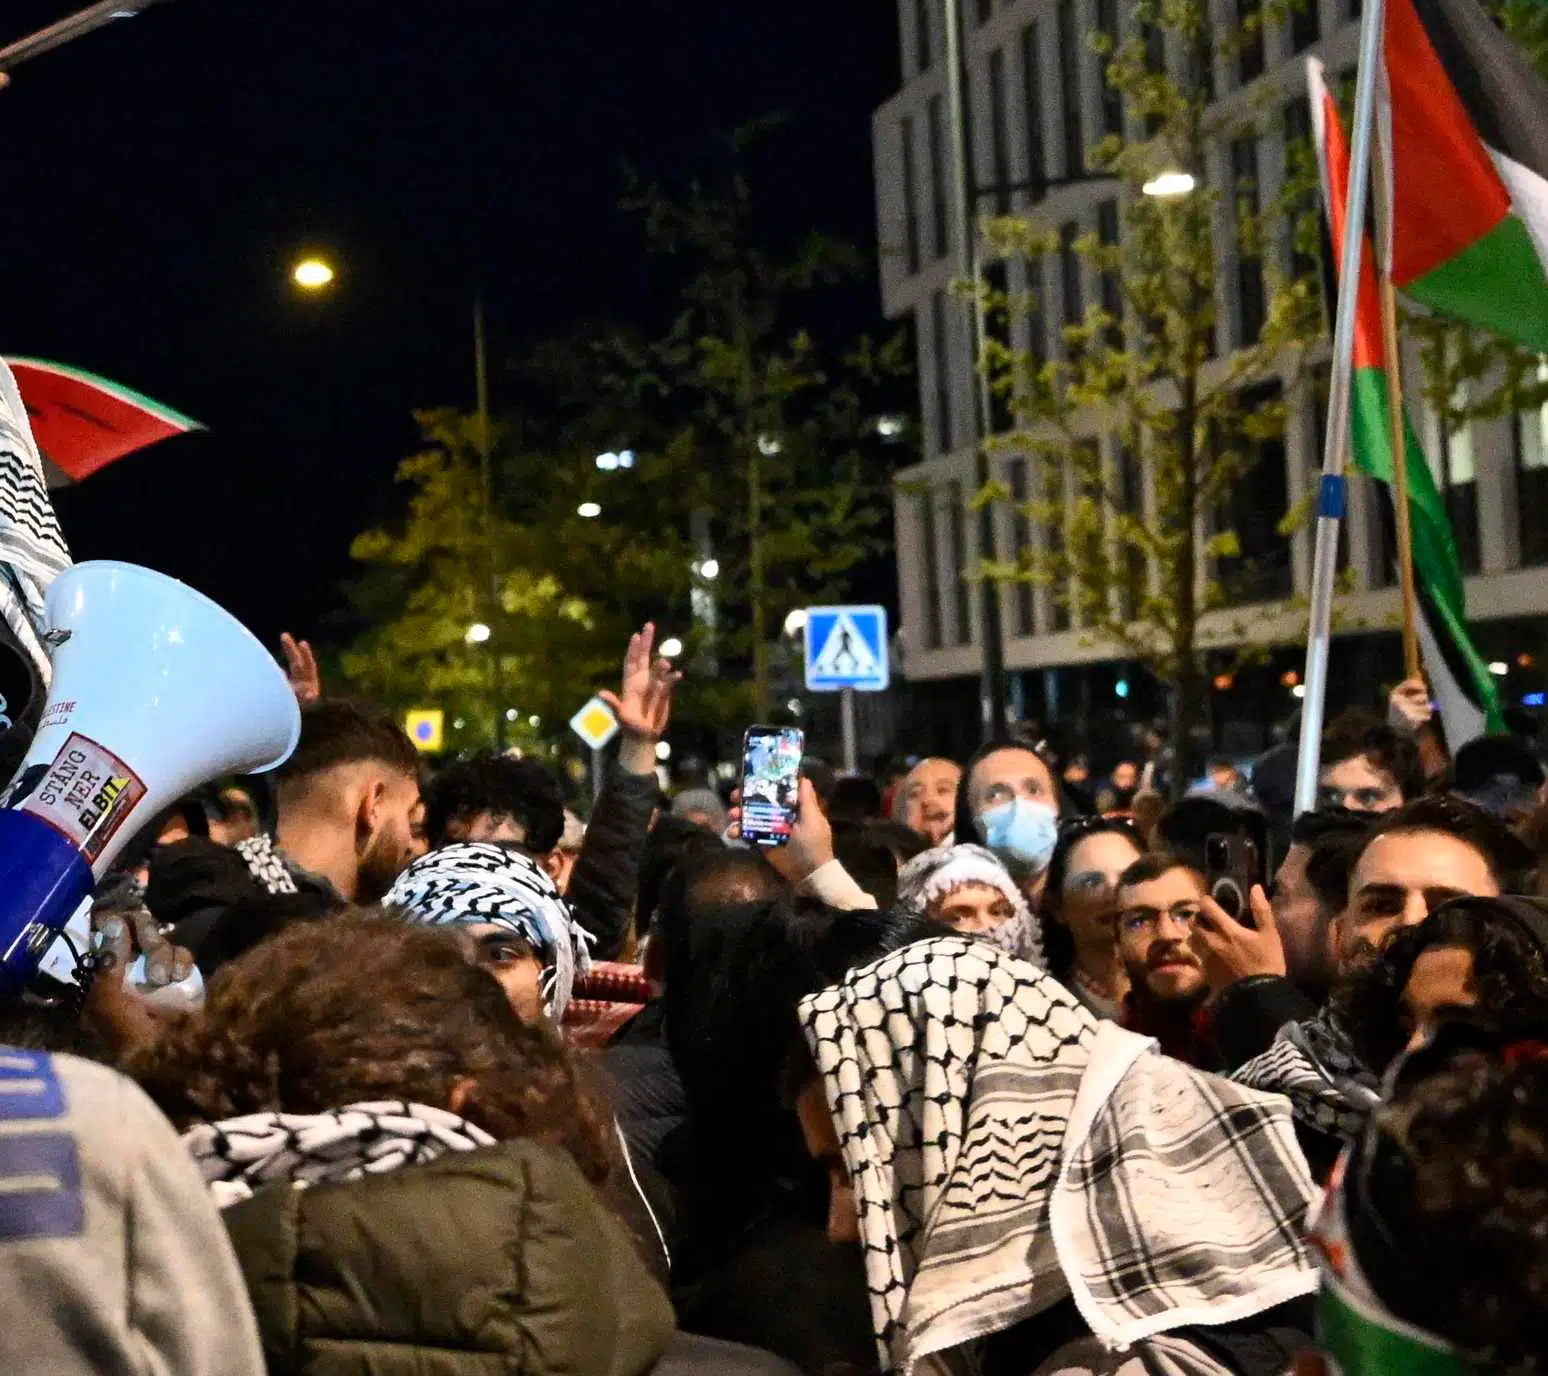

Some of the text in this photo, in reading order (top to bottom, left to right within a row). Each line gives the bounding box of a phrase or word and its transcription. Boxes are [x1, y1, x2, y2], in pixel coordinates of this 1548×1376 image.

[38, 749, 87, 806] STÄNG
[63, 769, 101, 811] NER
[78, 775, 121, 832] ELBIT
